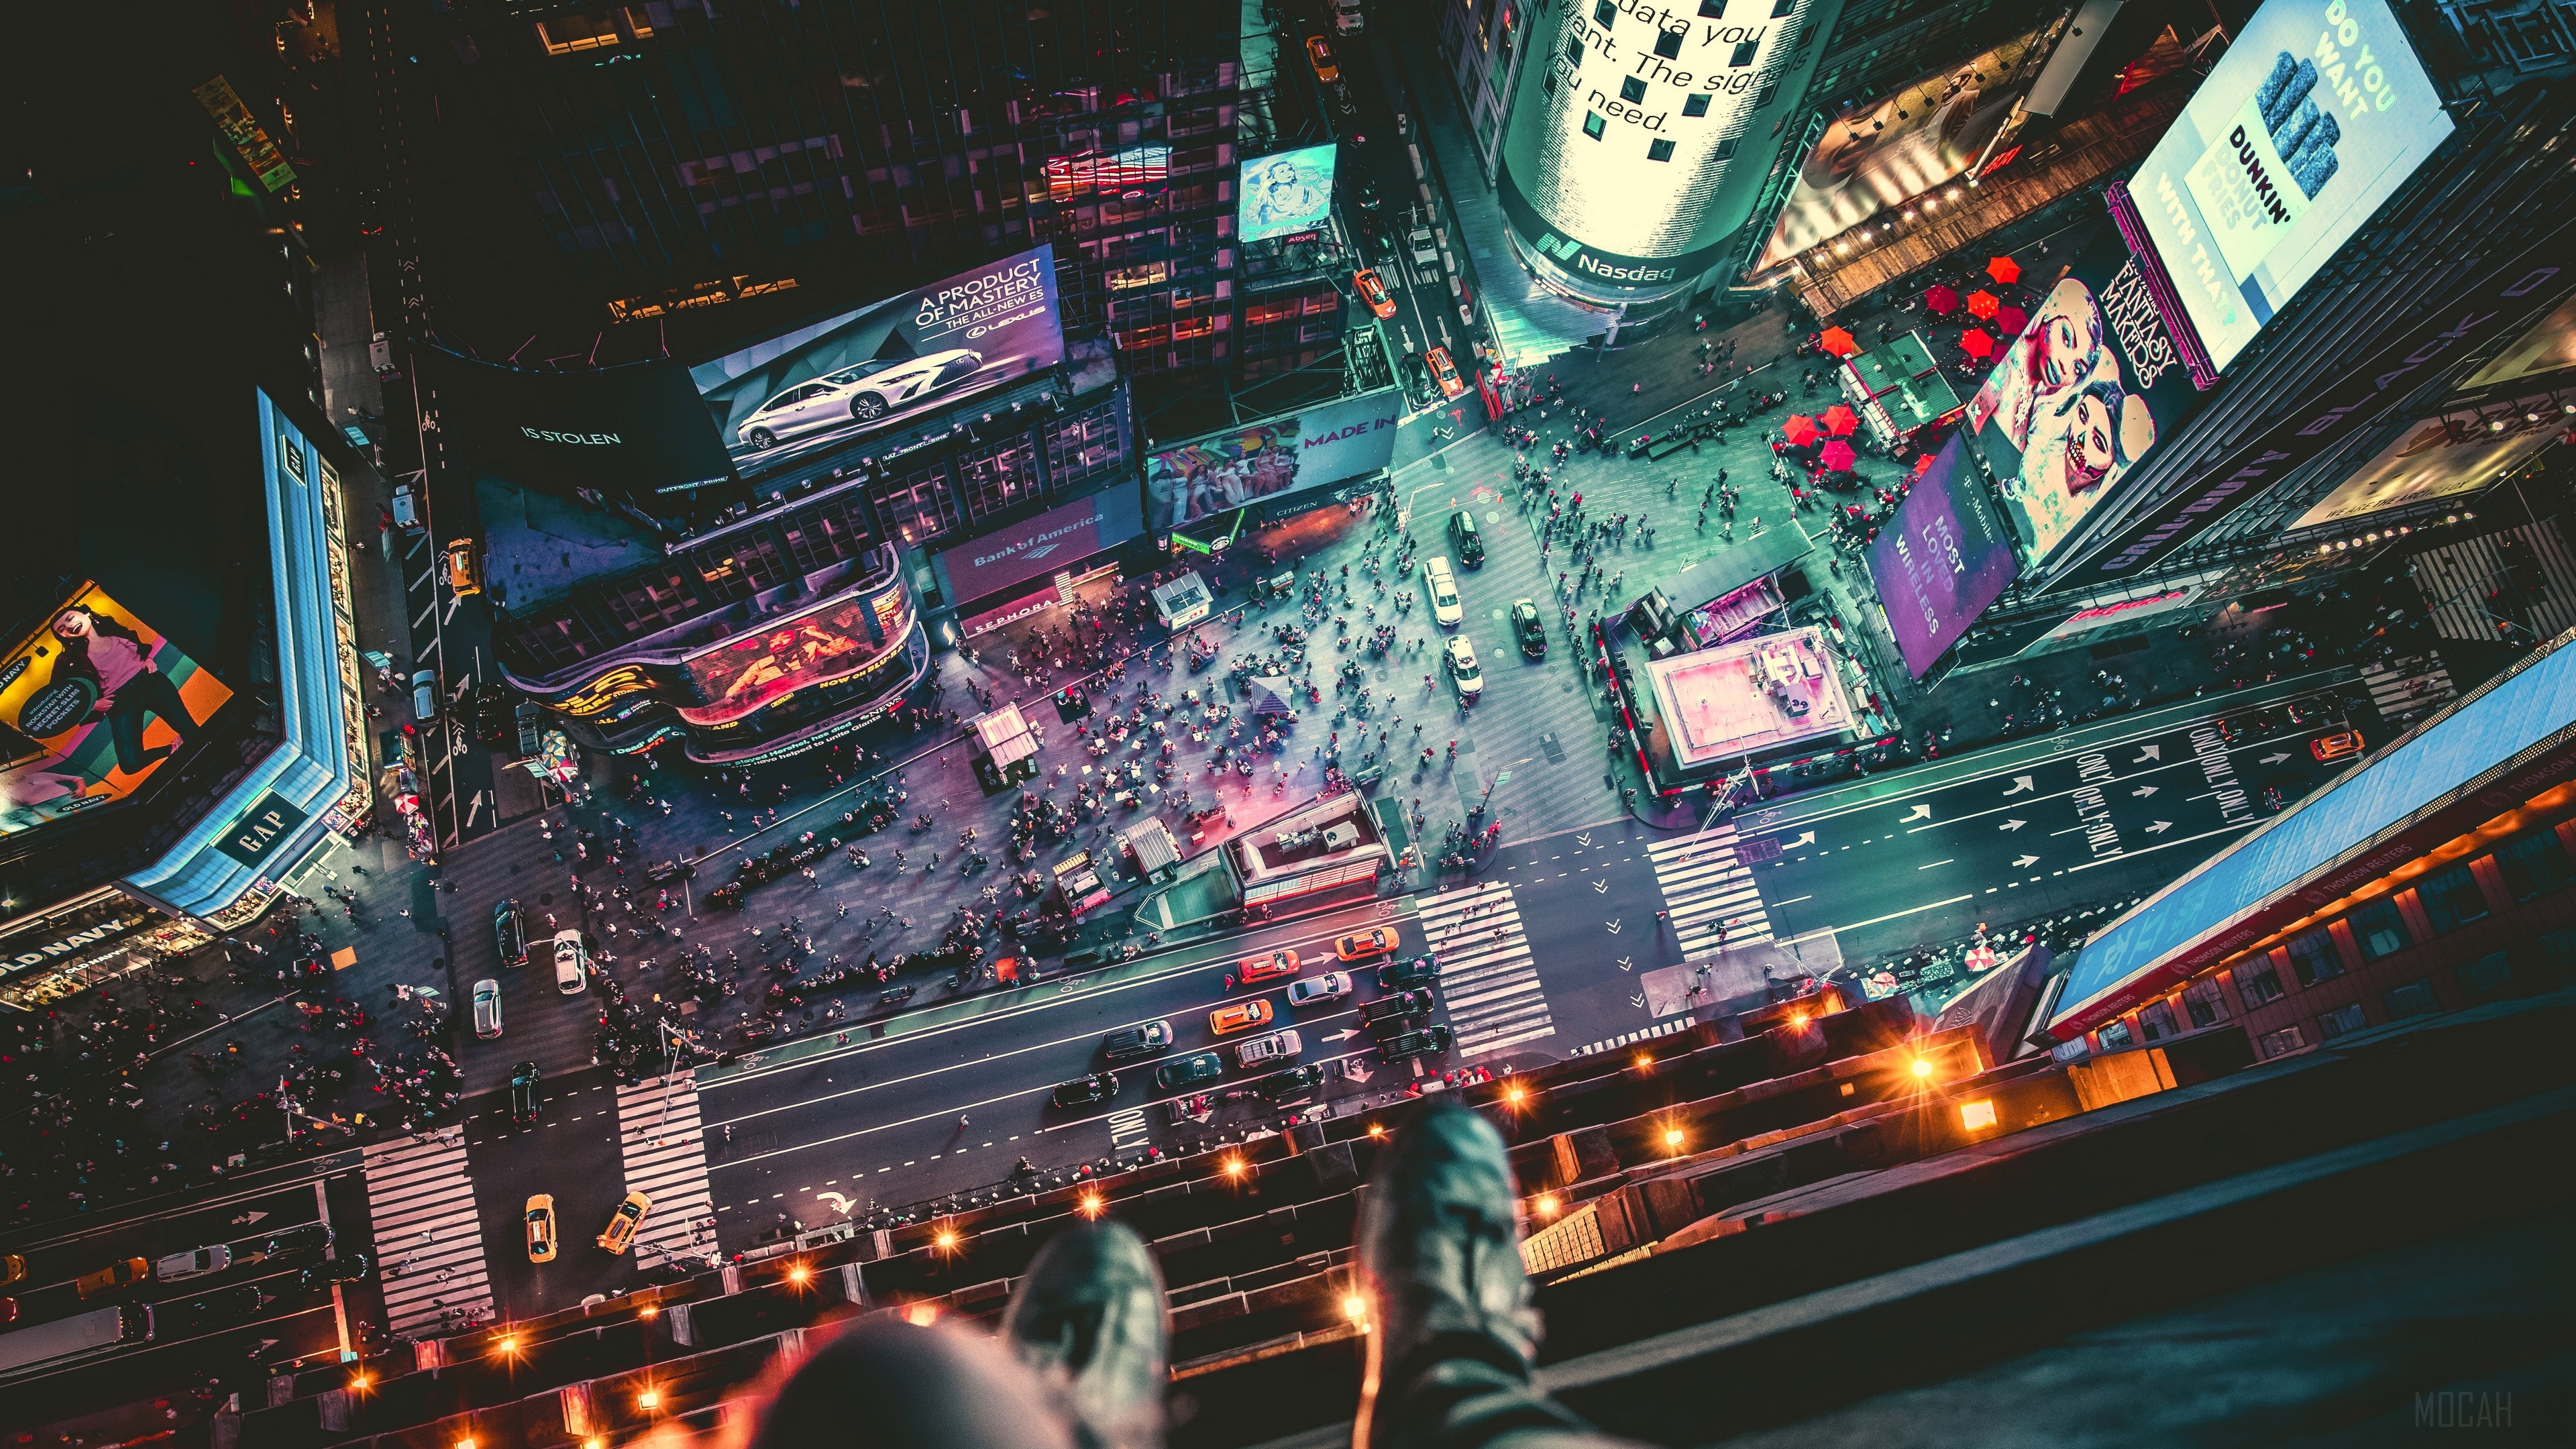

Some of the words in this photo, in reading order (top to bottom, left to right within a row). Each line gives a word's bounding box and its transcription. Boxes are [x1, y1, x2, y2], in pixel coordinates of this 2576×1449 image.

[1701, 25, 1768, 47] you
[1636, 52, 1693, 87] The
[1703, 51, 1811, 95] signals
[2325, 0, 2359, 48] DO
[2355, 44, 2397, 113] YOU
[2315, 31, 2369, 121] WANT
[1588, 89, 1668, 133] need.
[2214, 142, 2267, 230] DONUT
[2230, 124, 2291, 224] DUNKIN'
[2157, 172, 2196, 246] WITH
[2201, 160, 2241, 229] FRIES
[1288, 233, 1316, 242] Absen
[920, 297, 935, 312] A
[938, 258, 1040, 305] PRODUCT
[1578, 253, 1676, 282] Nasdaq
[915, 307, 945, 326] OF
[949, 272, 1041, 316] MASTERY
[946, 315, 970, 329] THE
[973, 295, 1026, 321] ALL-NEW
[1029, 289, 1044, 301] ES
[988, 305, 1046, 330] LEXUS
[2099, 279, 2158, 389] MAKERS
[2115, 260, 2178, 376] FANTASY
[521, 426, 540, 439] IS
[541, 431, 621, 444] STOLEN
[1304, 421, 1369, 449] MADE
[1374, 415, 1397, 430] IN
[2101, 519, 2195, 570] CALL
[2180, 449, 2292, 513] DUTY
[2295, 310, 2500, 435] BLACK
[290, 447, 301, 473] GAP
[1277, 501, 1318, 517] CITIZEN
[2324, 506, 2347, 519] WE
[2343, 502, 2375, 514] ARE
[2375, 497, 2398, 508] THE
[2395, 488, 2443, 505] ARCTIC
[2439, 480, 2470, 494] FOX
[974, 545, 1016, 568] Bank
[1016, 537, 1034, 550] of
[1037, 513, 1104, 543] America
[1935, 515, 1965, 574] MOST
[1921, 559, 1935, 584] IN
[1922, 524, 1954, 593] LOVED
[885, 588, 900, 603] SOL
[975, 600, 1053, 633] SEPHORA
[2, 660, 26, 685] NAVY
[819, 676, 851, 689] NOW
[852, 670, 866, 680] ON
[25, 697, 58, 728] ROCKSTAR
[56, 684, 74, 699] WITH
[30, 688, 58, 715] Introducing
[33, 688, 80, 733] SECRET-SLIM
[46, 698, 80, 730] POCKETS
[570, 694, 613, 714] WARS
[869, 696, 902, 717] NEWS
[647, 727, 671, 743] actor
[712, 721, 739, 731] AND
[735, 753, 767, 765] played
[811, 732, 829, 741] has
[831, 721, 852, 733] died
[778, 745, 812, 759] helped
[826, 730, 850, 742] unite
[851, 714, 881, 731] Giants
[2190, 727, 2229, 756] ONLY
[2077, 753, 2114, 782] ONLY
[2200, 755, 2239, 789] ONLY
[2508, 757, 2569, 792] THOMSON
[62, 802, 80, 812] OLD
[79, 795, 105, 806] NAVY
[2072, 788, 2110, 822] ONLY
[2216, 789, 2255, 824] ONLY
[239, 811, 285, 852] GAP
[2086, 822, 2123, 858] ONLY
[2322, 863, 2371, 894] THOMSON
[2369, 844, 2413, 869] REUTERS
[41, 919, 125, 956] NAVY
[2187, 945, 2222, 967] THOMSON
[2220, 929, 2255, 950] REUTERS
[65, 963, 89, 974] OLD
[89, 950, 121, 966] NAVY
[2082, 1007, 2110, 1024] THOMSON
[2108, 994, 2136, 1010] REUTERS
[1108, 1110, 1150, 1150] ONLY
